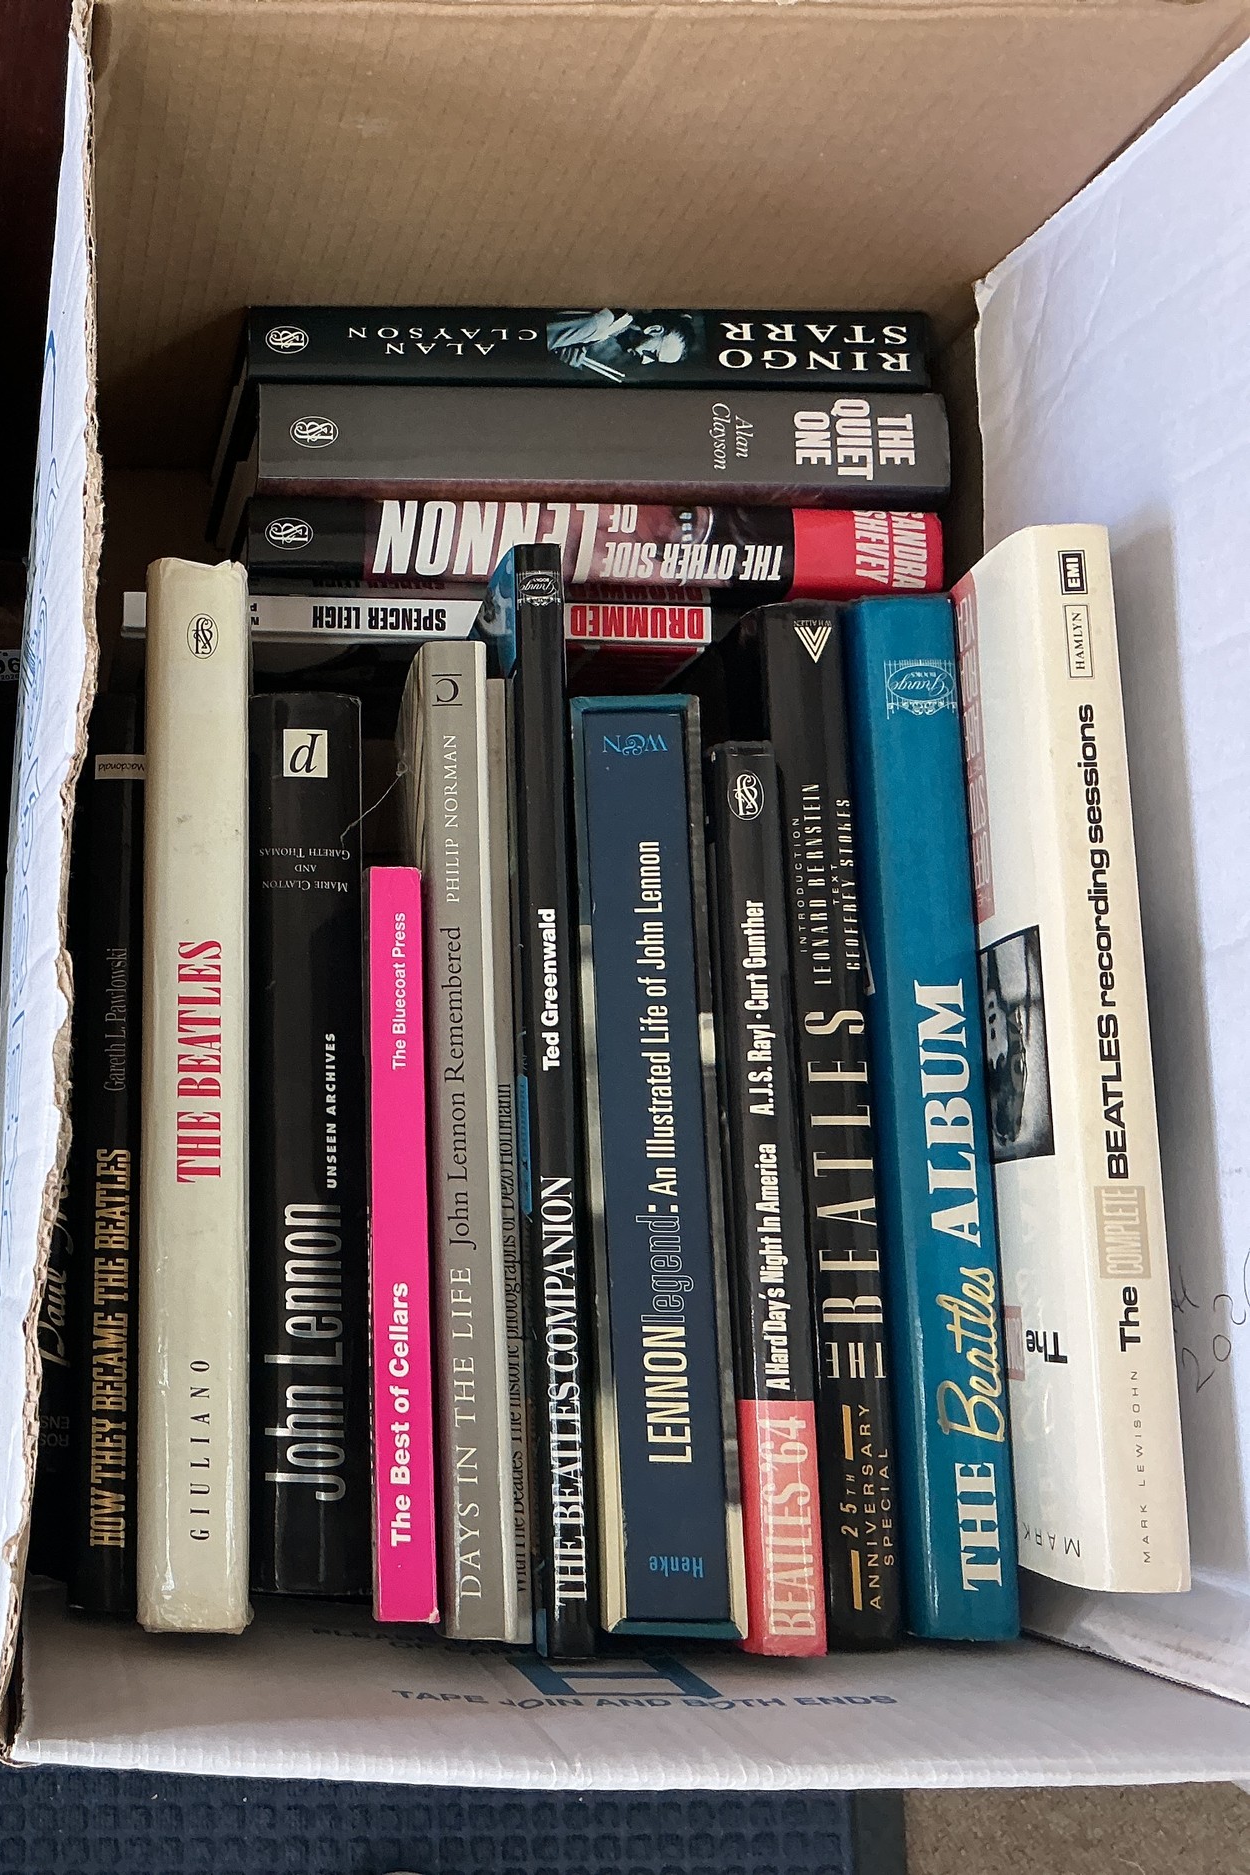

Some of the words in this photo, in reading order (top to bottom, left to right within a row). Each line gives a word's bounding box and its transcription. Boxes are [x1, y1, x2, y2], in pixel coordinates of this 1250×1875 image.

[348, 327, 537, 340] CLAYSON
[385, 341, 496, 355] ALAN
[719, 347, 911, 371] RINGO
[721, 322, 907, 343] STARR
[713, 401, 731, 470] Clayson
[736, 415, 754, 457] Alan
[794, 410, 832, 465] ONE
[835, 398, 874, 480] QUIET
[879, 413, 915, 465] THE
[608, 504, 638, 532] OF
[600, 542, 657, 578] SIDE
[662, 544, 737, 579] OTHER
[741, 545, 783, 580] THE
[1066, 556, 1081, 587] EMI
[312, 606, 361, 629] LEIGH
[368, 607, 446, 631] SPENCER
[570, 605, 705, 638] DRUMMED
[1072, 612, 1085, 670] HAMLYN
[443, 734, 459, 827] NORMAN
[1076, 704, 1104, 844] sessions
[445, 838, 460, 903] PHILIP
[634, 840, 663, 911] Lennon
[392, 912, 406, 957] Press
[635, 917, 667, 970] John
[742, 900, 768, 968] Gunther
[1087, 849, 1116, 1007] recording
[391, 962, 407, 1034] Bluecoat
[538, 909, 558, 1026] Greenwald
[640, 976, 665, 996] of
[745, 973, 769, 1010] Curt
[177, 939, 222, 1098] BEATLES
[542, 1031, 560, 1070] Ted
[640, 1003, 669, 1043] Life
[746, 1023, 775, 1061] Rayl
[325, 1032, 336, 1115] ARCHIVES
[392, 1038, 407, 1069] The
[643, 1052, 676, 1159] Illustrated
[748, 1066, 775, 1115] A.J.S.
[913, 980, 981, 1249] ALBUM
[1097, 1015, 1129, 1179] BEATLES
[177, 1112, 221, 1183] THE
[326, 1123, 337, 1188] UNSEEN
[95, 1149, 131, 1250] BEATLES
[648, 1167, 678, 1196] An
[1100, 1189, 1144, 1275] COMPLETE
[94, 1258, 129, 1304] THE
[264, 1203, 343, 1365] Lennon
[450, 1267, 472, 1339] LIFE
[540, 1177, 578, 1373] COMPANION
[389, 1283, 409, 1378] Cellars
[1118, 1287, 1141, 1352] The
[93, 1313, 128, 1411] BECAME
[936, 1267, 1005, 1442] Beatles
[389, 1387, 409, 1414] of
[452, 1356, 476, 1428] THE
[92, 1422, 128, 1482] THEY
[189, 1360, 210, 1540] GIULIANO
[264, 1386, 346, 1501] John
[390, 1422, 410, 1485] Best
[455, 1446, 479, 1484] IN
[548, 1383, 585, 1527] BEATLES
[91, 1489, 125, 1547] HOW
[390, 1495, 410, 1547] The
[456, 1502, 481, 1599] DAYS
[955, 1463, 1003, 1591] THE
[554, 1535, 588, 1607] THE
[763, 1483, 817, 1636] BEATLES
